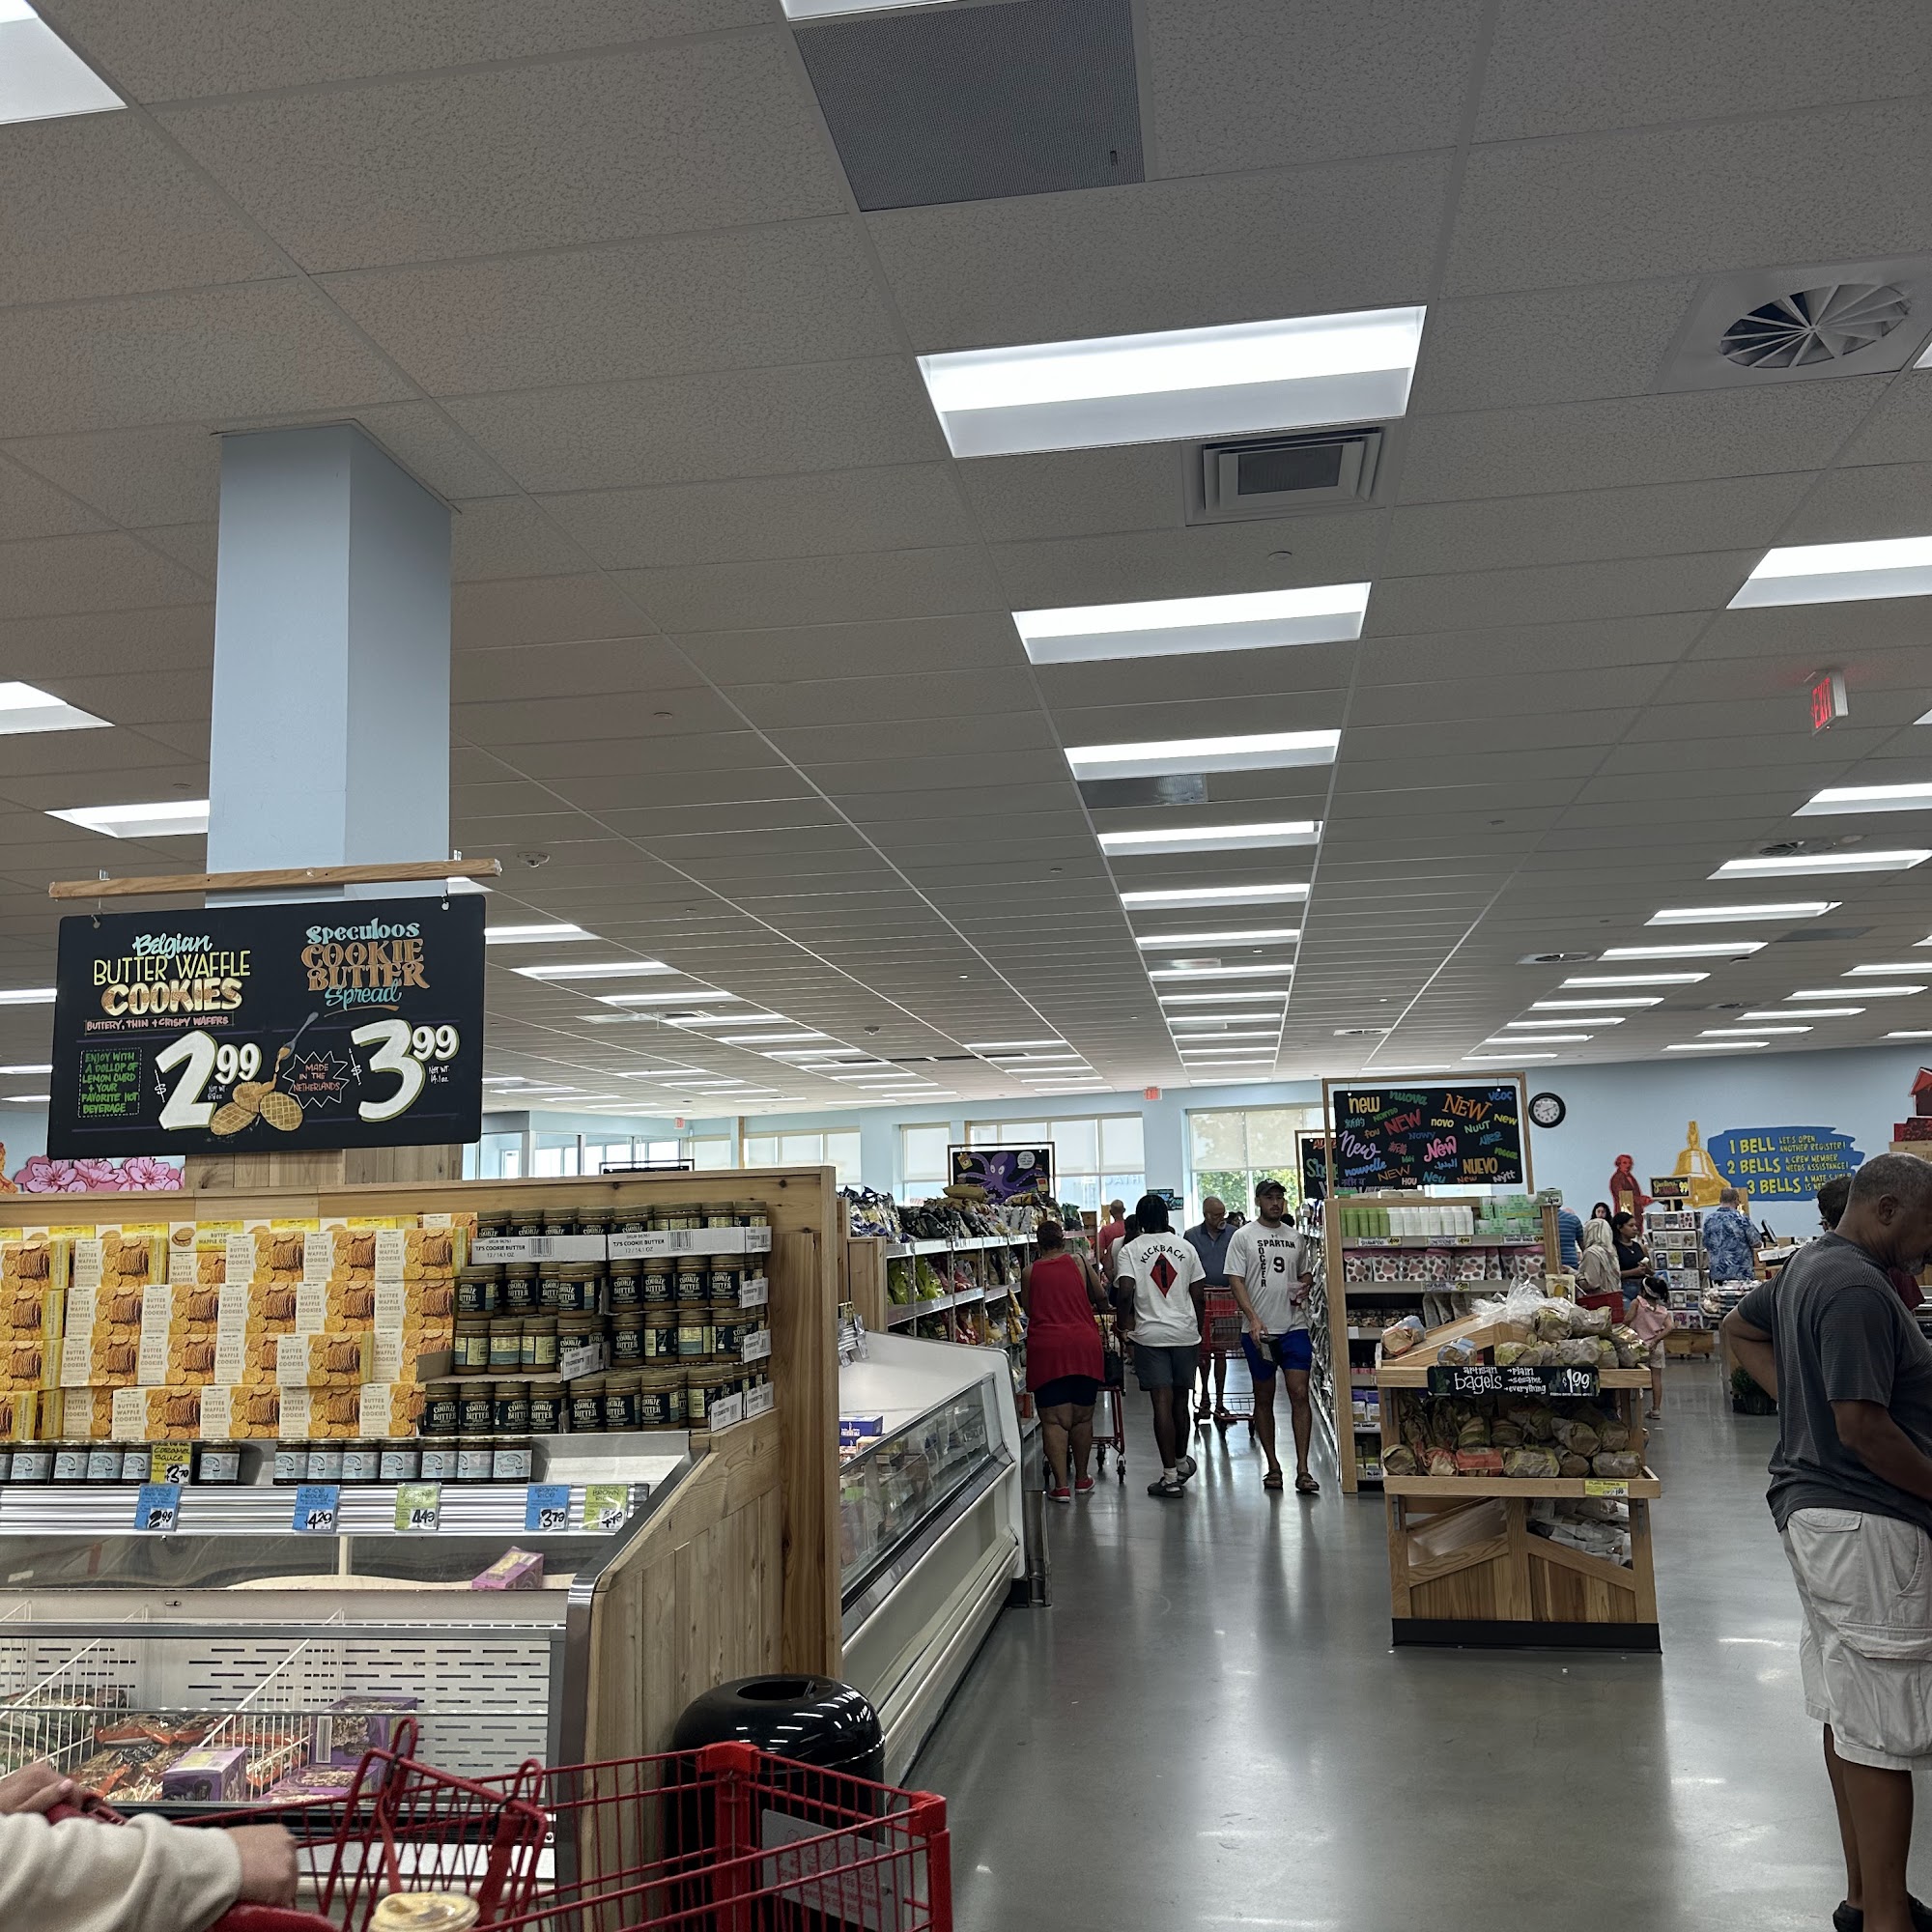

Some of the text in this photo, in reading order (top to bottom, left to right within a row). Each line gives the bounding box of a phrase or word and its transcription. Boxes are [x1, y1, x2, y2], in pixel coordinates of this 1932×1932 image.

[1812, 677, 1832, 728] EXIT
[305, 918, 421, 945] Speculoos
[131, 932, 213, 959] Belgian
[300, 938, 424, 968] COOKIE
[93, 950, 251, 986] BUTTER WAFFLE
[307, 962, 431, 991] BUTTER
[100, 977, 243, 1016] COOKIES
[325, 979, 403, 1011] Spread
[86, 1019, 126, 1032] BUTTERY,
[126, 1019, 149, 1029] THIN
[193, 1015, 229, 1026] WAFERS
[85, 1051, 135, 1064] ENJOY WITH
[85, 1062, 137, 1073] A DOLLOP OF
[304, 1063, 329, 1072] MADE
[82, 1073, 136, 1084] LEMON CURD
[293, 1082, 341, 1092] NETHERLANDS
[96, 1084, 118, 1093] YOUR
[81, 1092, 139, 1103] FAVORITE HOT
[1349, 1096, 1380, 1114] new
[1389, 1091, 1428, 1105] nuova
[83, 1103, 126, 1114] BEVERAGE
[1441, 1093, 1493, 1122] NEW
[1383, 1108, 1422, 1136] NEW
[1431, 1118, 1455, 1128] novo
[1339, 1129, 1381, 1160] New
[1729, 1137, 1776, 1154] 1 BELL
[1778, 1134, 1816, 1145] LET'S OPEN
[1779, 1141, 1846, 1153] ANOTHER REGISTER!
[1344, 1156, 1387, 1177] nouvelle
[1462, 1156, 1498, 1175] NUEVO
[1727, 1157, 1781, 1175] 2 BELLS
[1785, 1161, 1849, 1173] NEEDS ASSISTANCE!
[1791, 1155, 1810, 1164] CREW
[1811, 1153, 1838, 1163] MEMBER
[1377, 1164, 1411, 1181] NEW
[1423, 1171, 1446, 1184] Neu
[1747, 1179, 1756, 1195] 3
[1759, 1178, 1802, 1194] BELLS
[1257, 1239, 1296, 1249] SPARTAN
[1140, 1244, 1186, 1264] KICKBACK
[1273, 1256, 1286, 1273] 9
[1155, 1259, 1169, 1288] 1
[1463, 1366, 1534, 1376] artisan plain
[1454, 1373, 1502, 1395] bagels
[1509, 1385, 1547, 1395] everything
